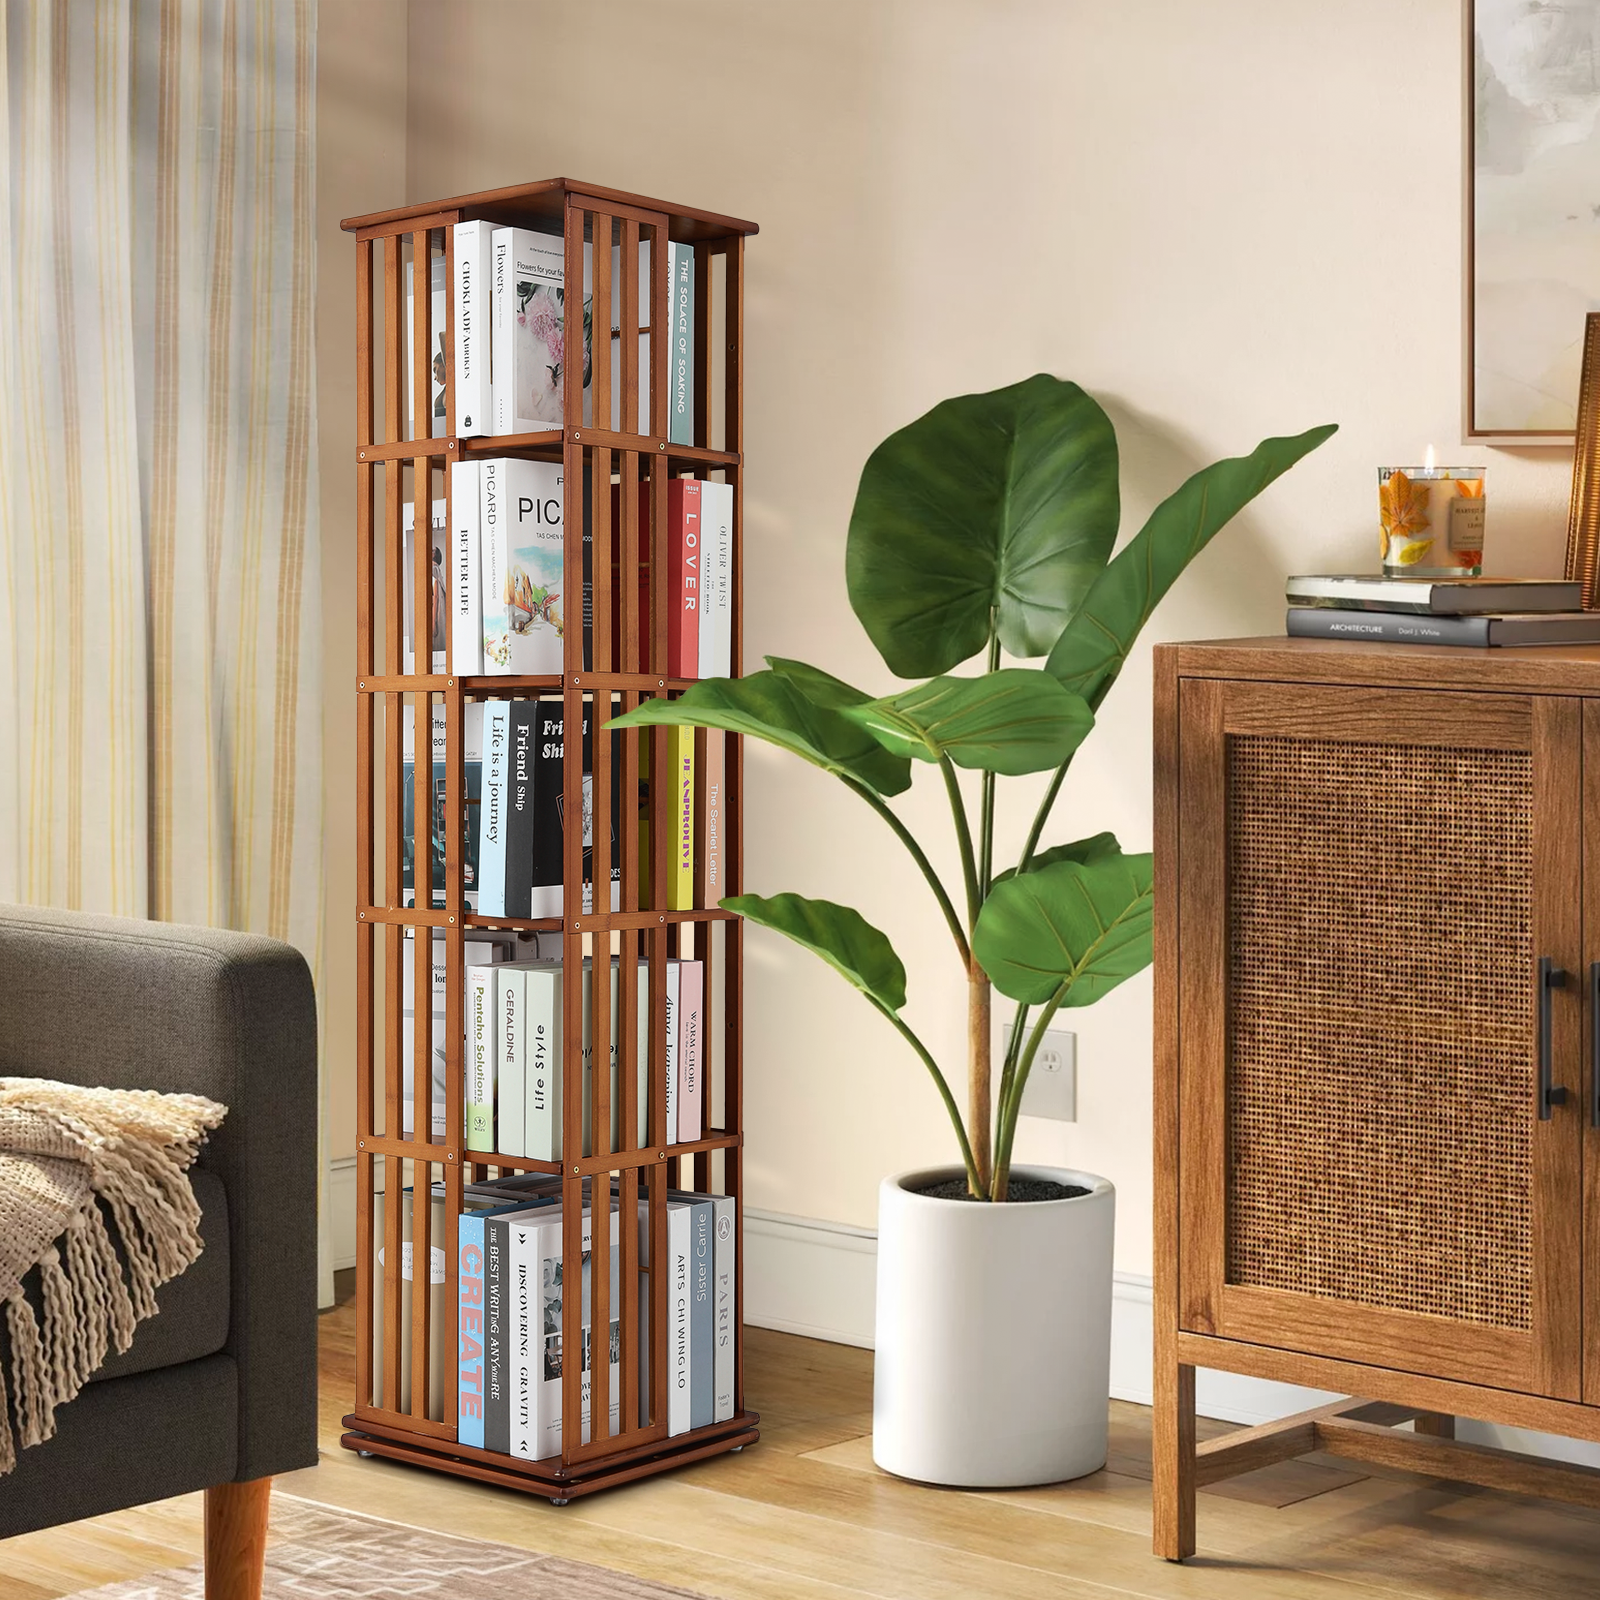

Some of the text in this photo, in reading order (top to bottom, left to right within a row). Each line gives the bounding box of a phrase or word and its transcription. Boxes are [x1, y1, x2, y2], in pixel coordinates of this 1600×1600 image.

[497, 244, 506, 294] Flowers
[517, 261, 536, 272] Flowers
[537, 265, 545, 273] for
[545, 268, 557, 276] your
[462, 261, 471, 379] CHOKLADFABRIKEN
[677, 260, 689, 414] THE SOLACE OF SOAKING
[486, 464, 496, 525] PICARD
[518, 497, 564, 526] PIC
[685, 485, 699, 493] ISSUE
[461, 529, 469, 616] BETTER LIFE
[685, 513, 697, 611] LOVER
[718, 525, 727, 608] OLIVER TWIST
[1329, 623, 1384, 634] ARCHITECTURE
[1420, 628, 1441, 637] White
[491, 715, 504, 748] Life
[491, 753, 503, 765] is
[516, 724, 529, 781] Friend
[541, 742, 564, 759] Shi
[542, 719, 588, 736] Frid
[486, 780, 503, 844] journey
[515, 785, 526, 811] Ship
[709, 783, 719, 886] The Scarlet Letter
[476, 986, 485, 1040] Pentaho
[505, 988, 515, 1064] GERALDINE
[476, 1045, 485, 1104] Solutions
[534, 1024, 546, 1110] Life Style
[688, 1011, 697, 1093] WARM CHORD
[696, 1212, 707, 1302] Sister Carrie
[460, 1243, 483, 1420] CREATE
[489, 1227, 501, 1400] THE BEST WRITING ANYWHERE
[677, 1254, 686, 1389] ARTS CHI WING LO
[719, 1273, 729, 1348] PARIS
[518, 1264, 529, 1429] IDSCOVERING GRAVITY
